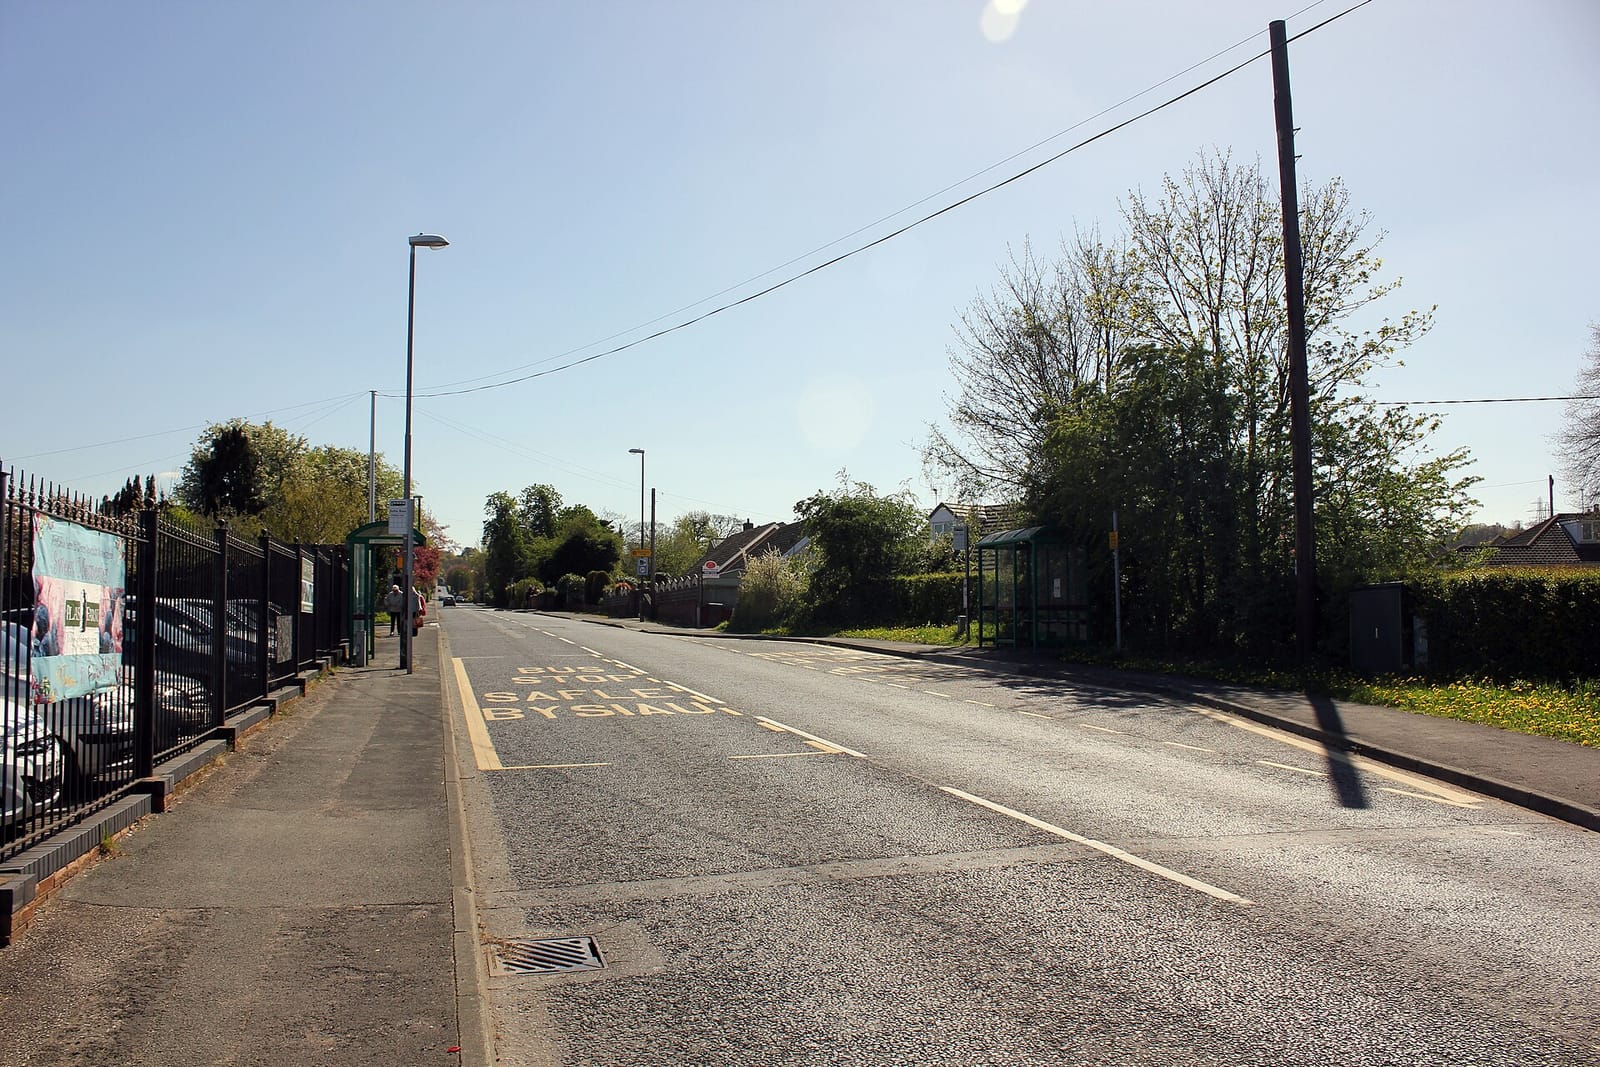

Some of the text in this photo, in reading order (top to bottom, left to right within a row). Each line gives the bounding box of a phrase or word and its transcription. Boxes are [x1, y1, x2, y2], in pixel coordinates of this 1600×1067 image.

[517, 666, 604, 675] BUS
[511, 674, 638, 685] STOP
[483, 688, 674, 703] SAFLE
[481, 702, 716, 721] BYSIAU
